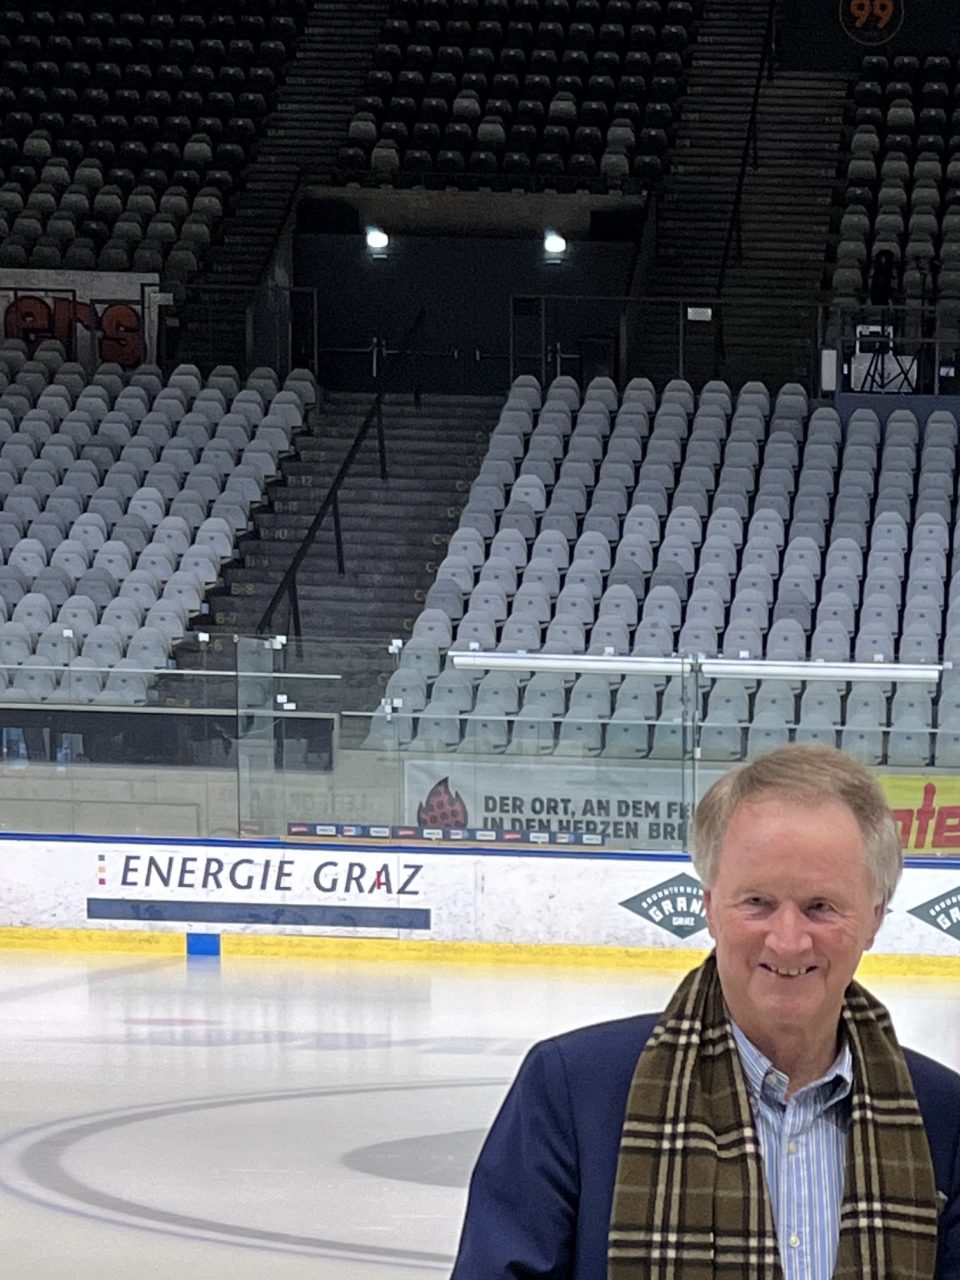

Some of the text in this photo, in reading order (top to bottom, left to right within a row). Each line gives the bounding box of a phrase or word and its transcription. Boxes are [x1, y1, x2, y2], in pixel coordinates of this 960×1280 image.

[849, 0, 895, 28] 99
[484, 795, 524, 814] DER
[531, 797, 576, 819] ORT,
[582, 799, 610, 817] AN
[617, 800, 660, 819] DEM
[121, 855, 424, 896] ENERGIE GRAZ
